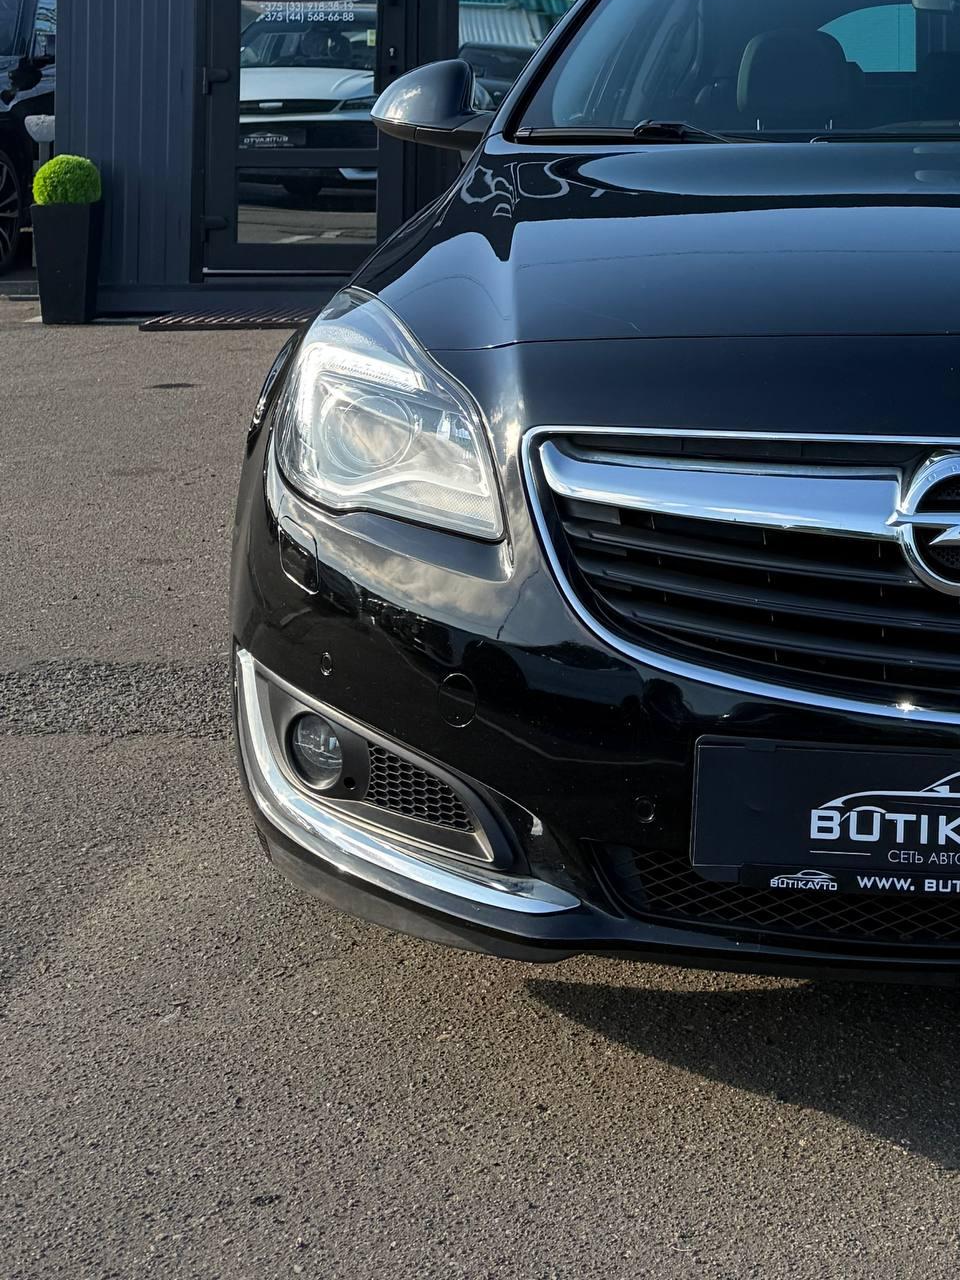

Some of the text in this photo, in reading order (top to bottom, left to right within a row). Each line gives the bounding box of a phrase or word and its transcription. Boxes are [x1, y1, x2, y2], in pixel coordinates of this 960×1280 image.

[286, 11, 304, 23] (44)
[308, 11, 354, 21] 568-66-88
[887, 849, 924, 864] СЕТЬ
[770, 878, 838, 891] BUTIKAVTO
[857, 875, 915, 891] WWW.
